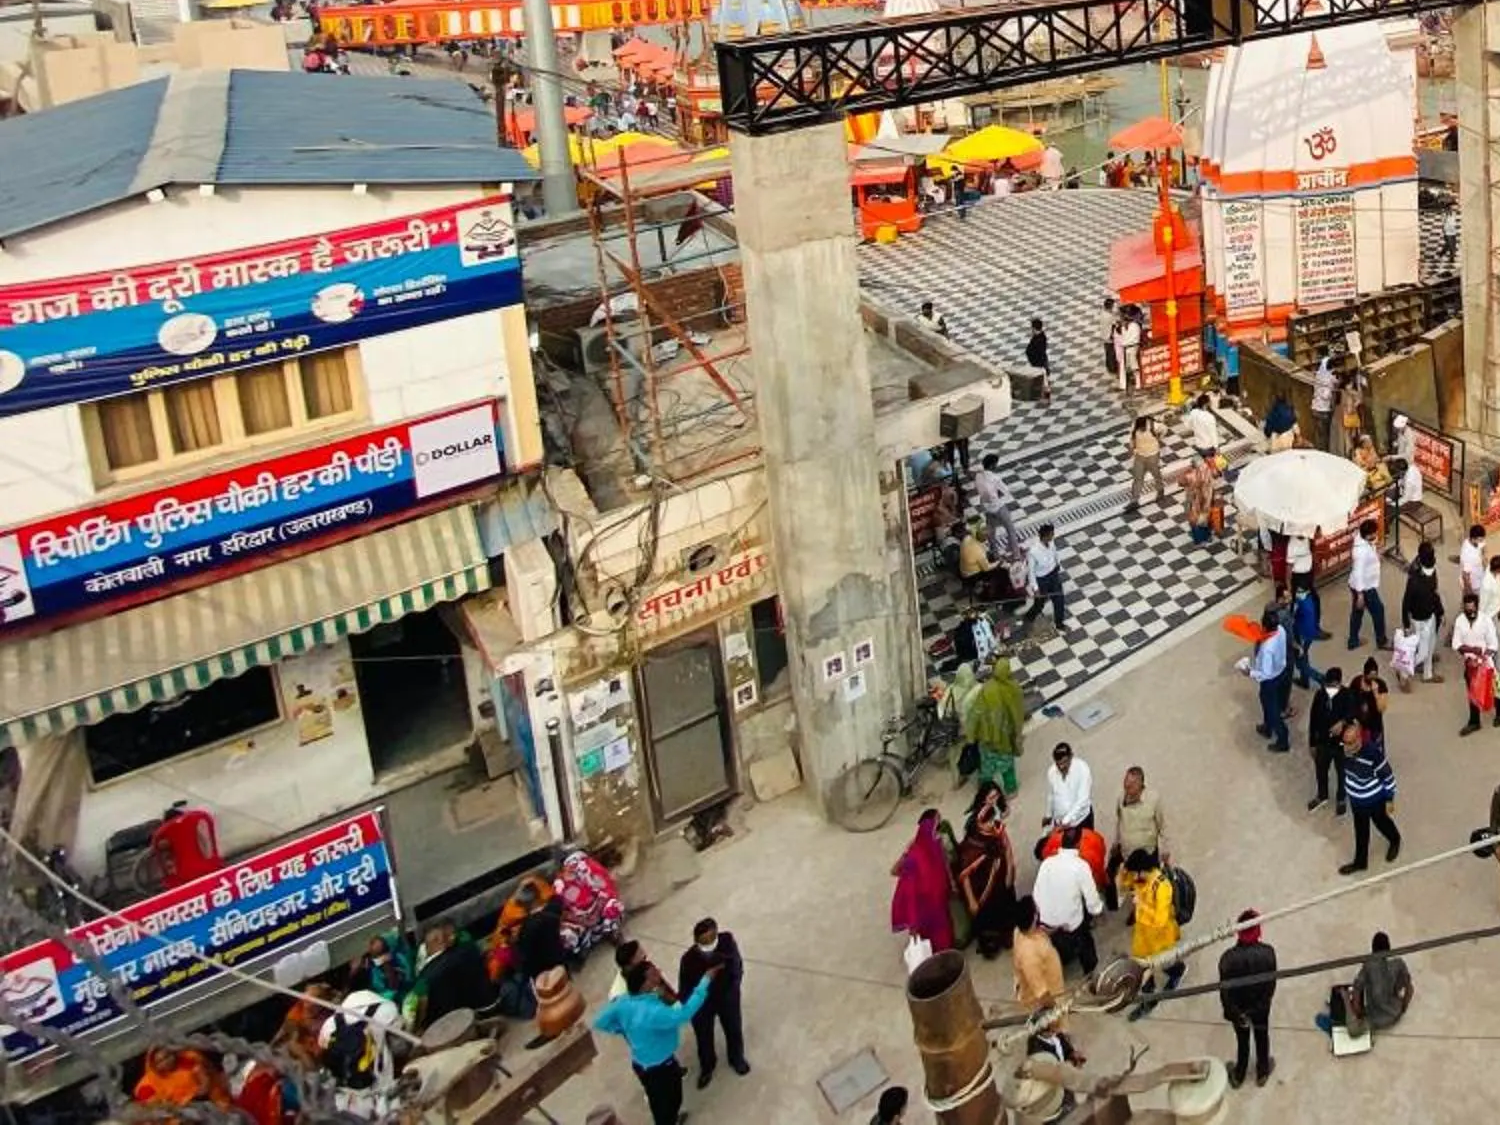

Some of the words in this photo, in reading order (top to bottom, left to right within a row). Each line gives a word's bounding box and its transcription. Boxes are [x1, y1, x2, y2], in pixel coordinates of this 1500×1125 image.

[9, 292, 79, 325] गज
[89, 275, 139, 311] की
[148, 265, 203, 314] दूरी
[212, 251, 300, 289] मास्क
[312, 237, 336, 273] है
[431, 433, 493, 461] DOLLAR
[136, 497, 214, 549] पुलिस
[281, 466, 317, 502] हर
[317, 452, 353, 487] की
[84, 557, 165, 594] कोतवाली
[174, 545, 213, 570] नगर
[220, 525, 277, 557] हरिद्वार
[211, 876, 233, 907] के
[236, 866, 276, 899] लिए
[276, 856, 308, 880] यह
[311, 823, 365, 867] जरूरी
[311, 872, 347, 905] और
[348, 854, 378, 897] दूरी
